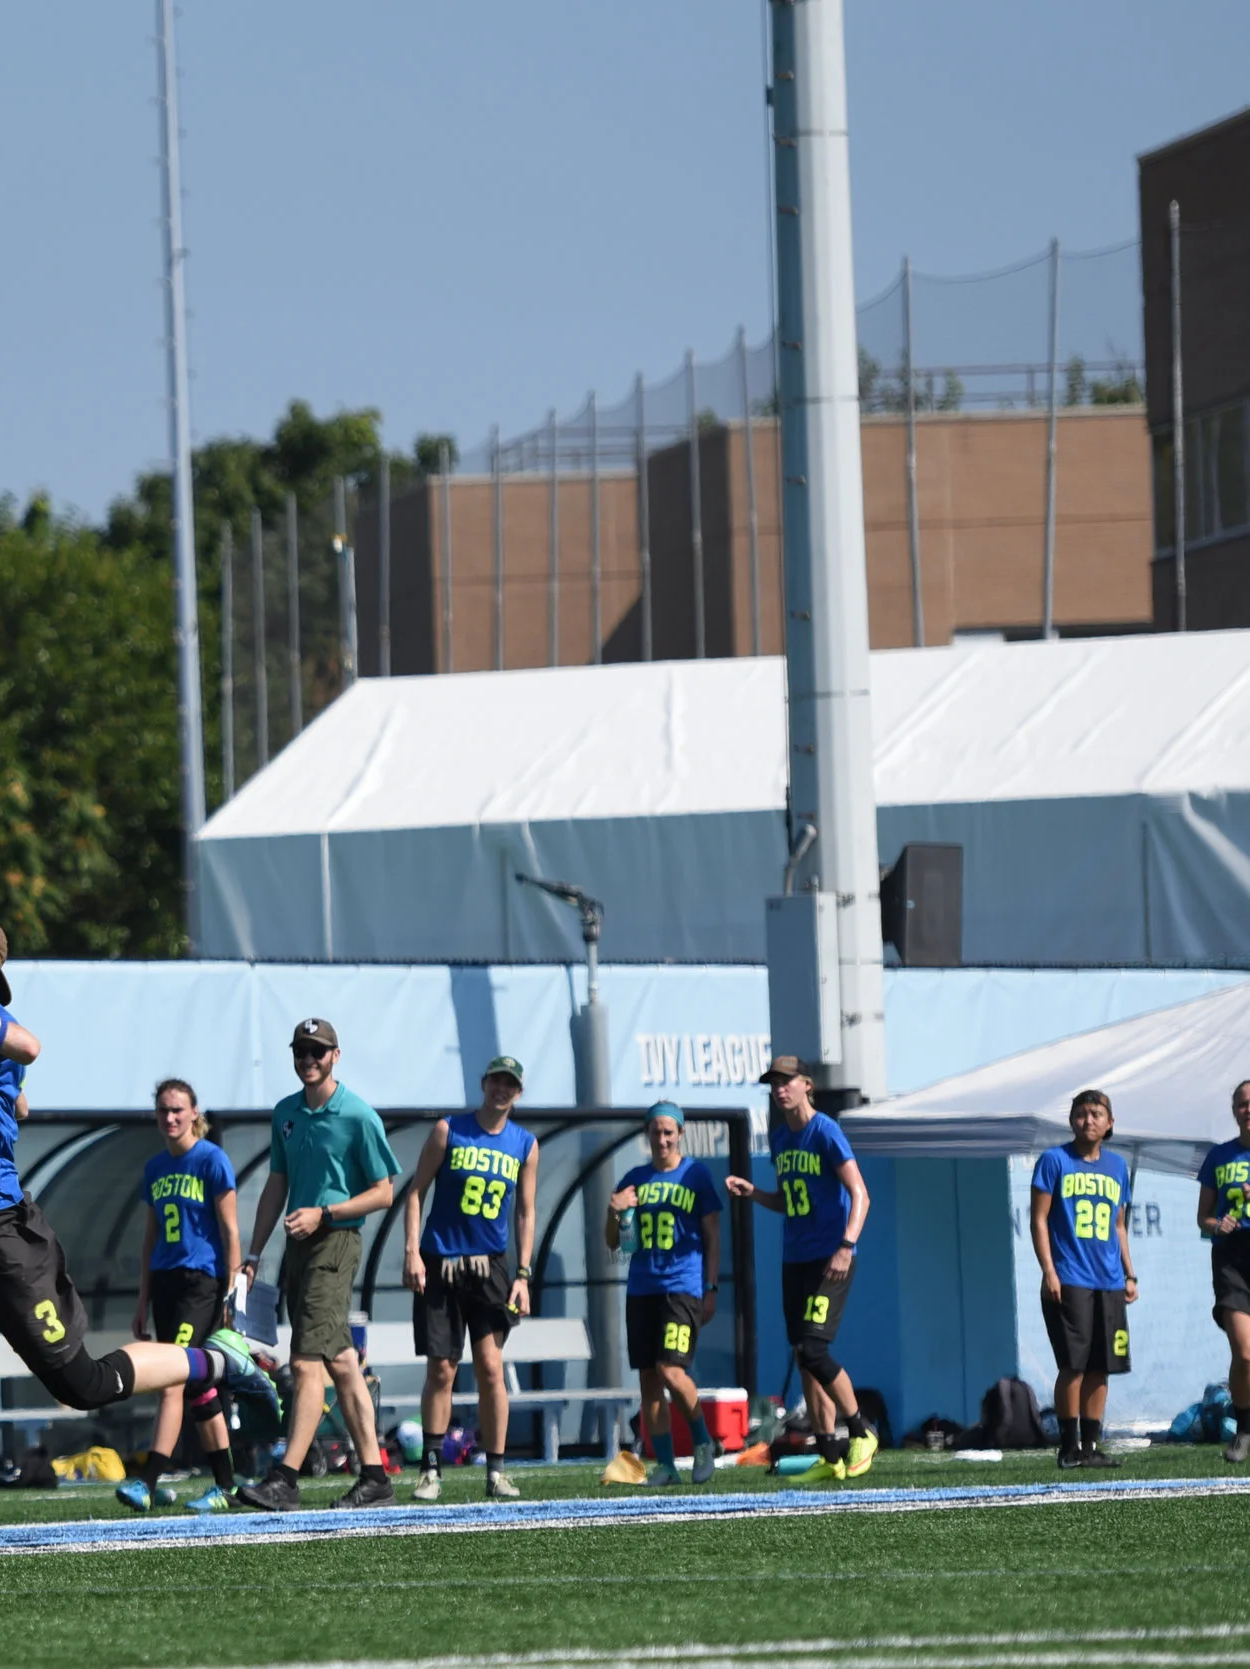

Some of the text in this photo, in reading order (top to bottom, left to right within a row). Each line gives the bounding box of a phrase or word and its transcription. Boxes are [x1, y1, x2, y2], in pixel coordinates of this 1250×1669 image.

[636, 1033, 680, 1085] IVY
[450, 1145, 521, 1182] BOSTON
[776, 1150, 821, 1176] OSTON
[461, 1175, 506, 1220] 83
[637, 1181, 695, 1213] OSTON
[782, 1178, 810, 1217] 13
[1062, 1172, 1121, 1206] BOSTON
[164, 1203, 181, 1243] 2
[640, 1211, 675, 1250] 26
[1075, 1199, 1111, 1241] 29
[35, 1299, 66, 1343] 3
[804, 1295, 830, 1324] 13
[175, 1322, 194, 1348] 2
[664, 1321, 692, 1353] 26
